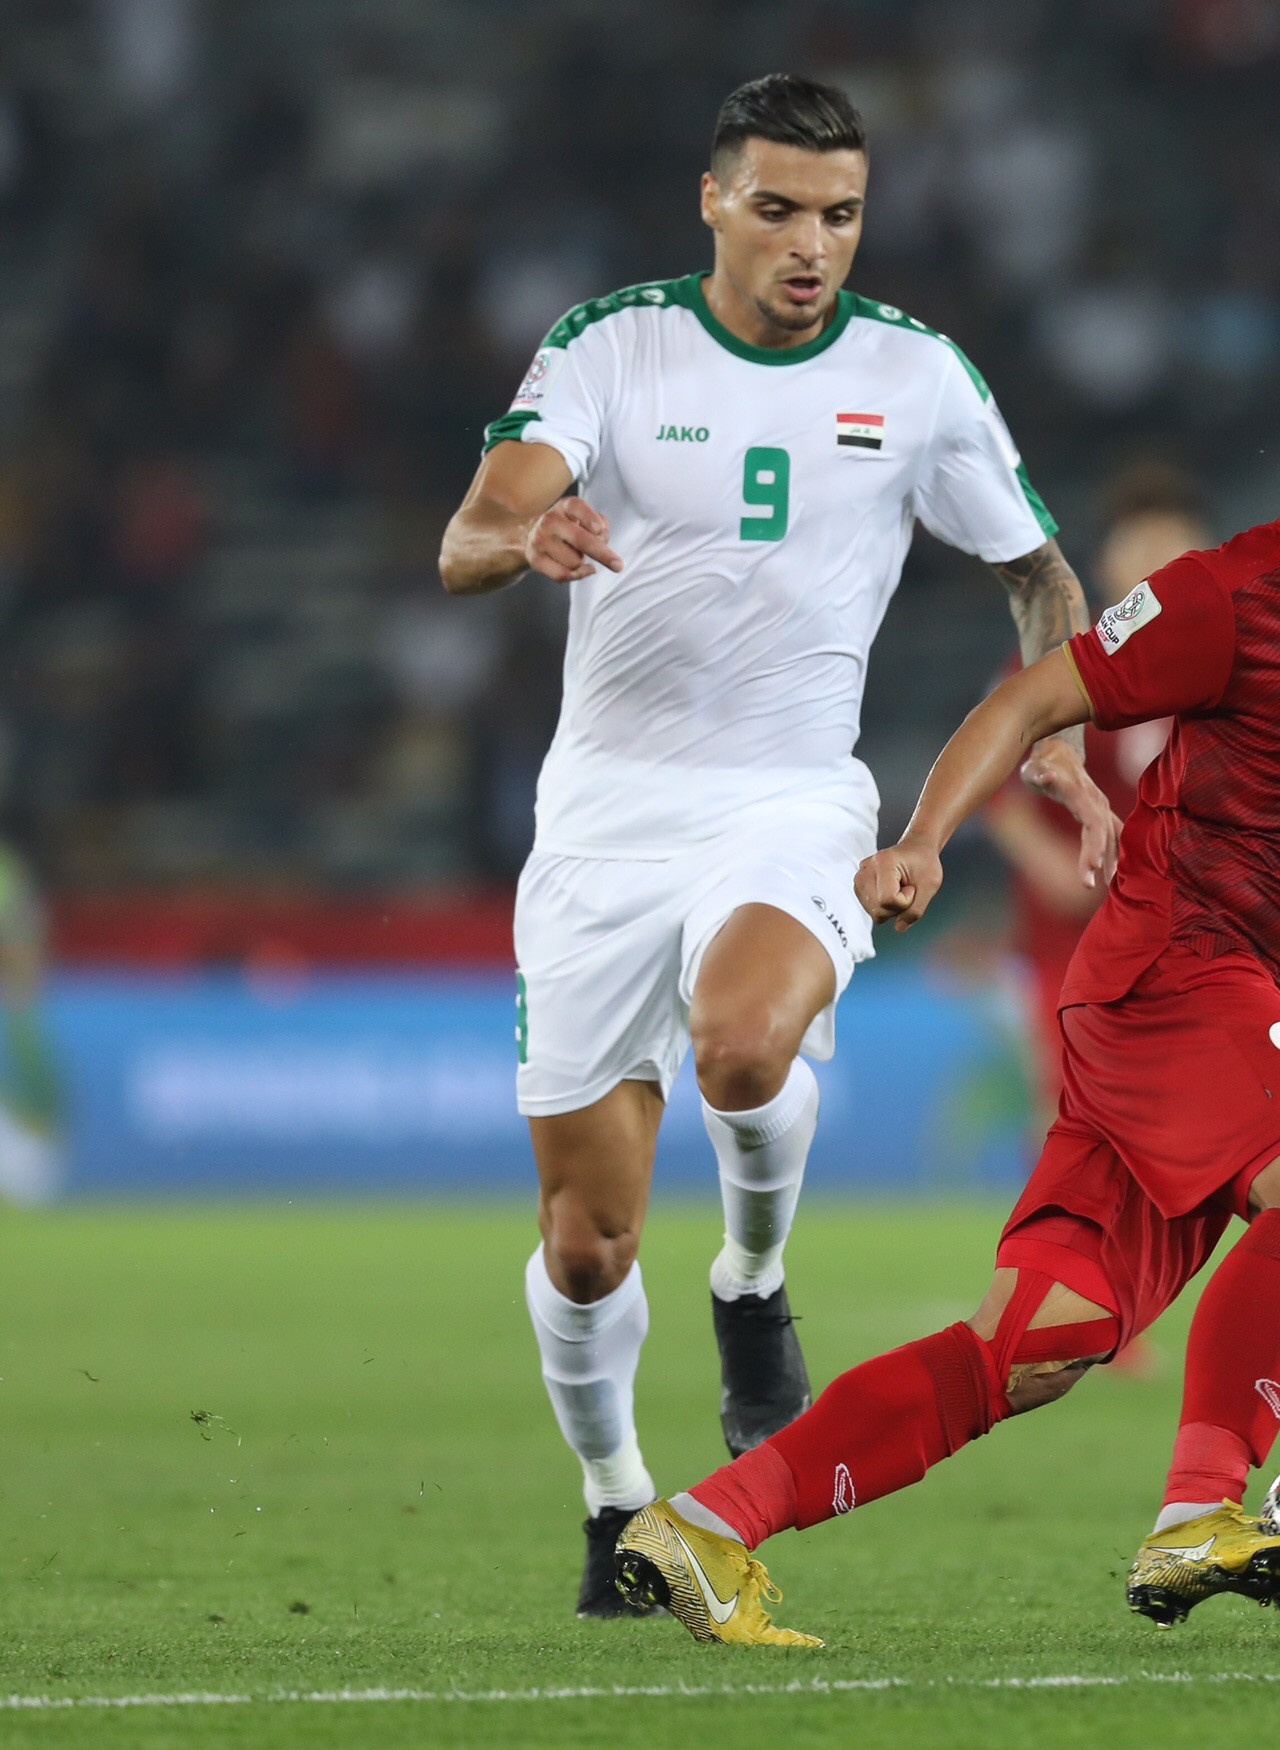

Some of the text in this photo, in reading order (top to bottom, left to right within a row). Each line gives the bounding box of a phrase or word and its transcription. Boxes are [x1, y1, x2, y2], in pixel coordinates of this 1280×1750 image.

[656, 425, 710, 442] JAKO
[740, 446, 790, 542] 9
[1105, 627, 1119, 643] CUP
[826, 913, 848, 948] JAKO
